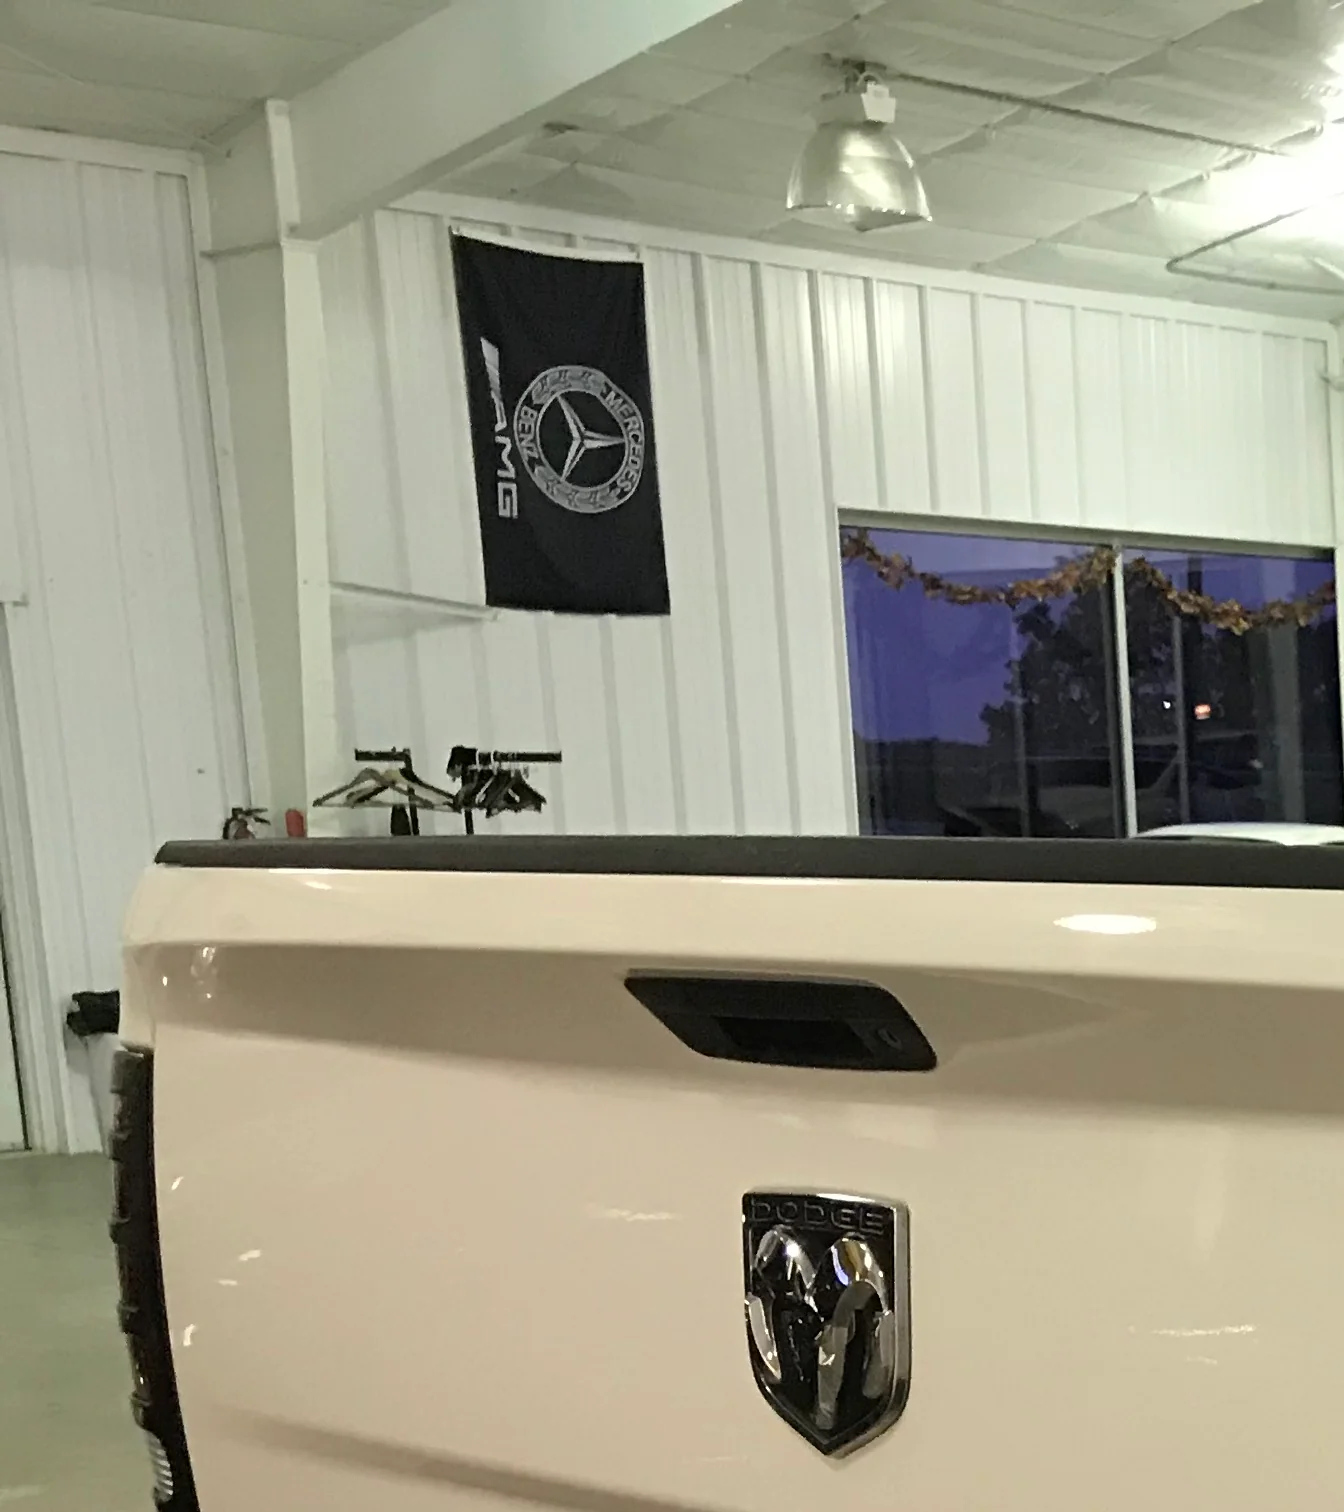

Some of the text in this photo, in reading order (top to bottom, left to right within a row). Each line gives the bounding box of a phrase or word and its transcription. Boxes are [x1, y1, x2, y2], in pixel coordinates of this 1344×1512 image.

[489, 382, 518, 519] AMG
[519, 405, 539, 461] BENZ
[604, 391, 642, 493] MERCEDES
[750, 1200, 885, 1234] DODGE
